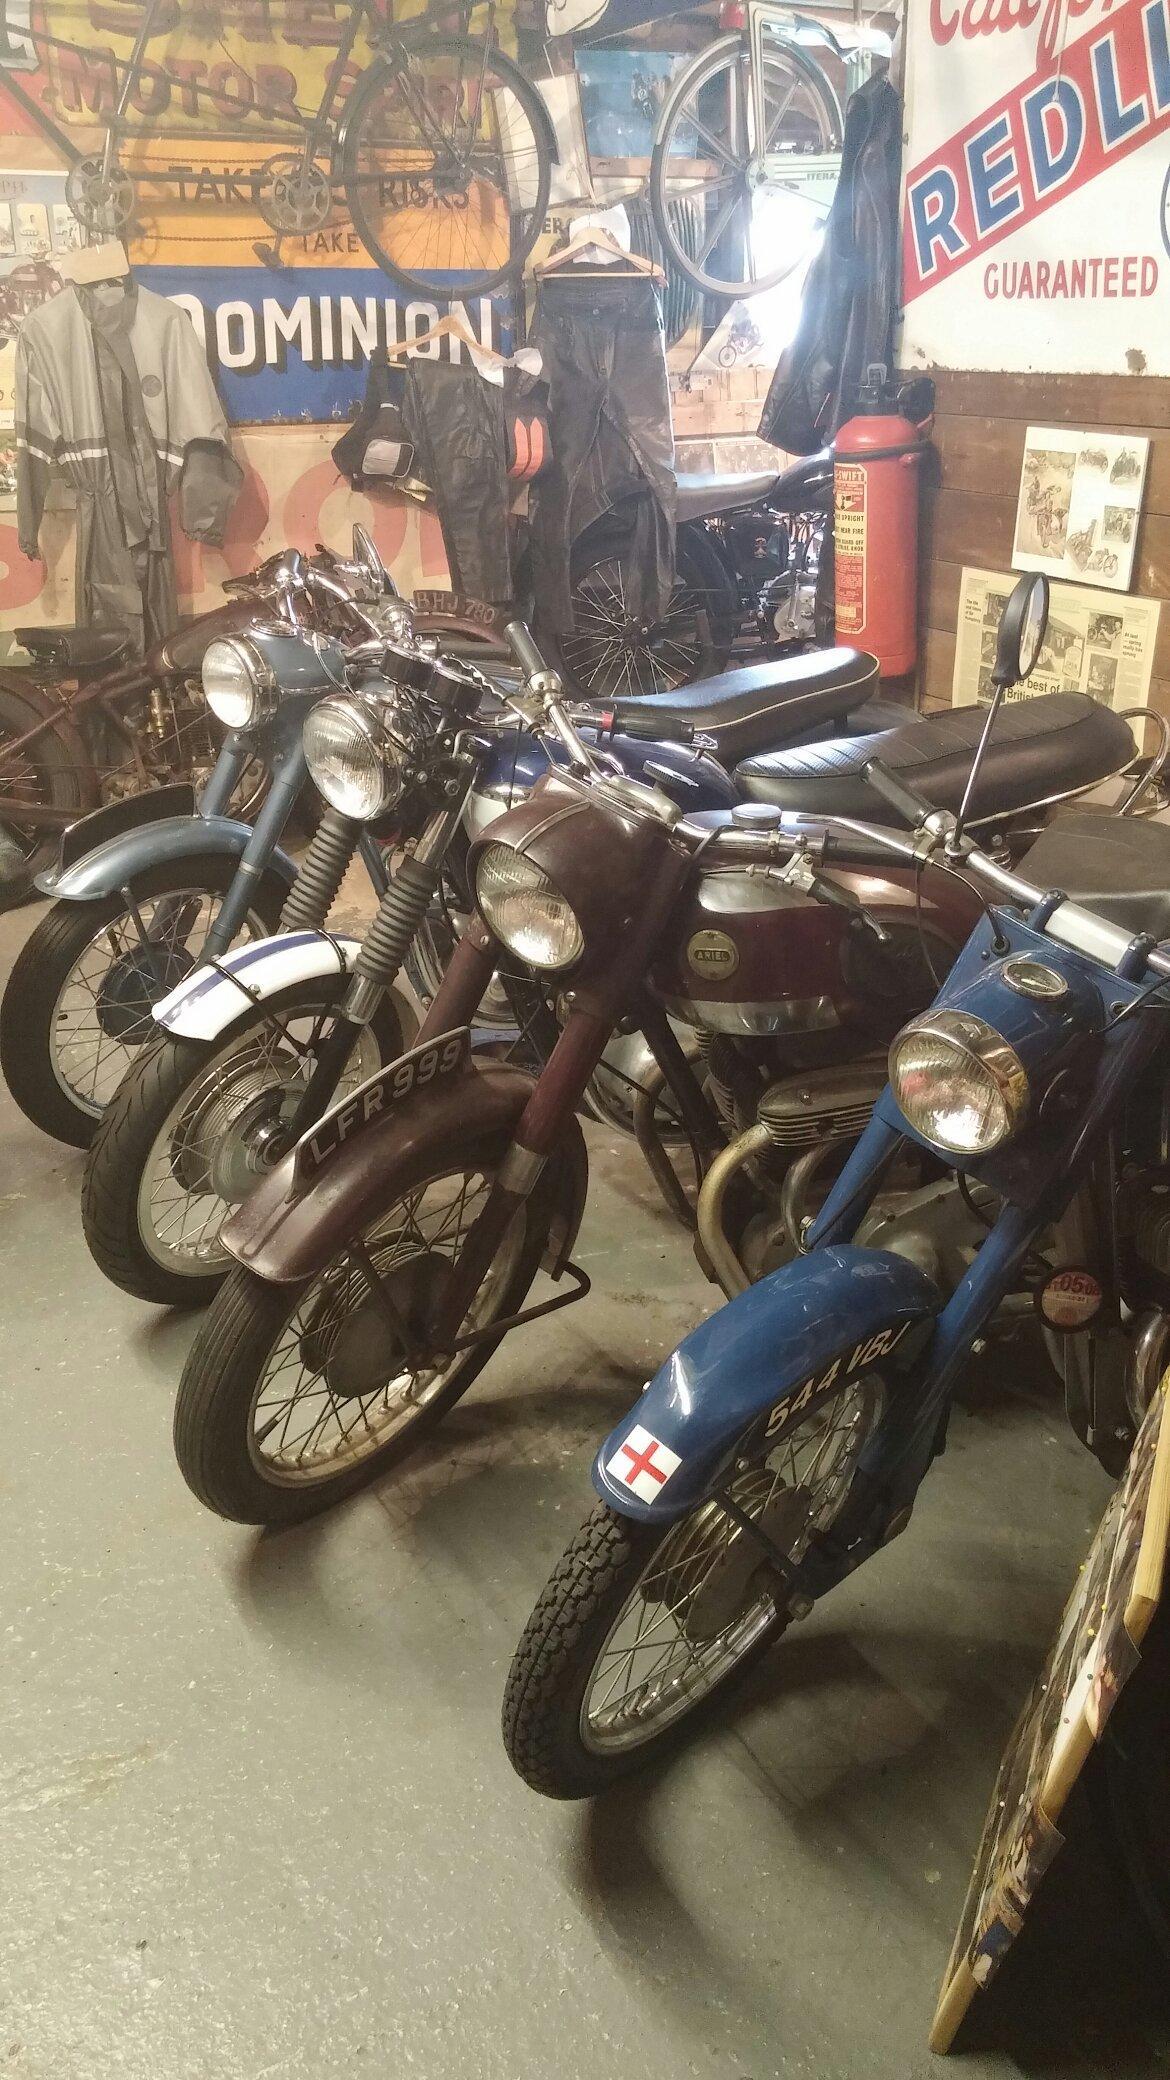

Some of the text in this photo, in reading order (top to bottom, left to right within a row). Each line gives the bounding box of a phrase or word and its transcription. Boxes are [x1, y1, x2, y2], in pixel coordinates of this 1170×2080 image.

[56, 47, 302, 122] MOTOR
[300, 232, 360, 253] TAKE
[983, 255, 1159, 300] GUARANTEED
[416, 591, 459, 612] BHJ
[1027, 678, 1047, 692] best
[1050, 684, 1061, 694] of
[697, 950, 729, 961] ARIEL
[309, 1039, 463, 1165] LFR 999
[764, 1320, 913, 1438] 544 VBJ
